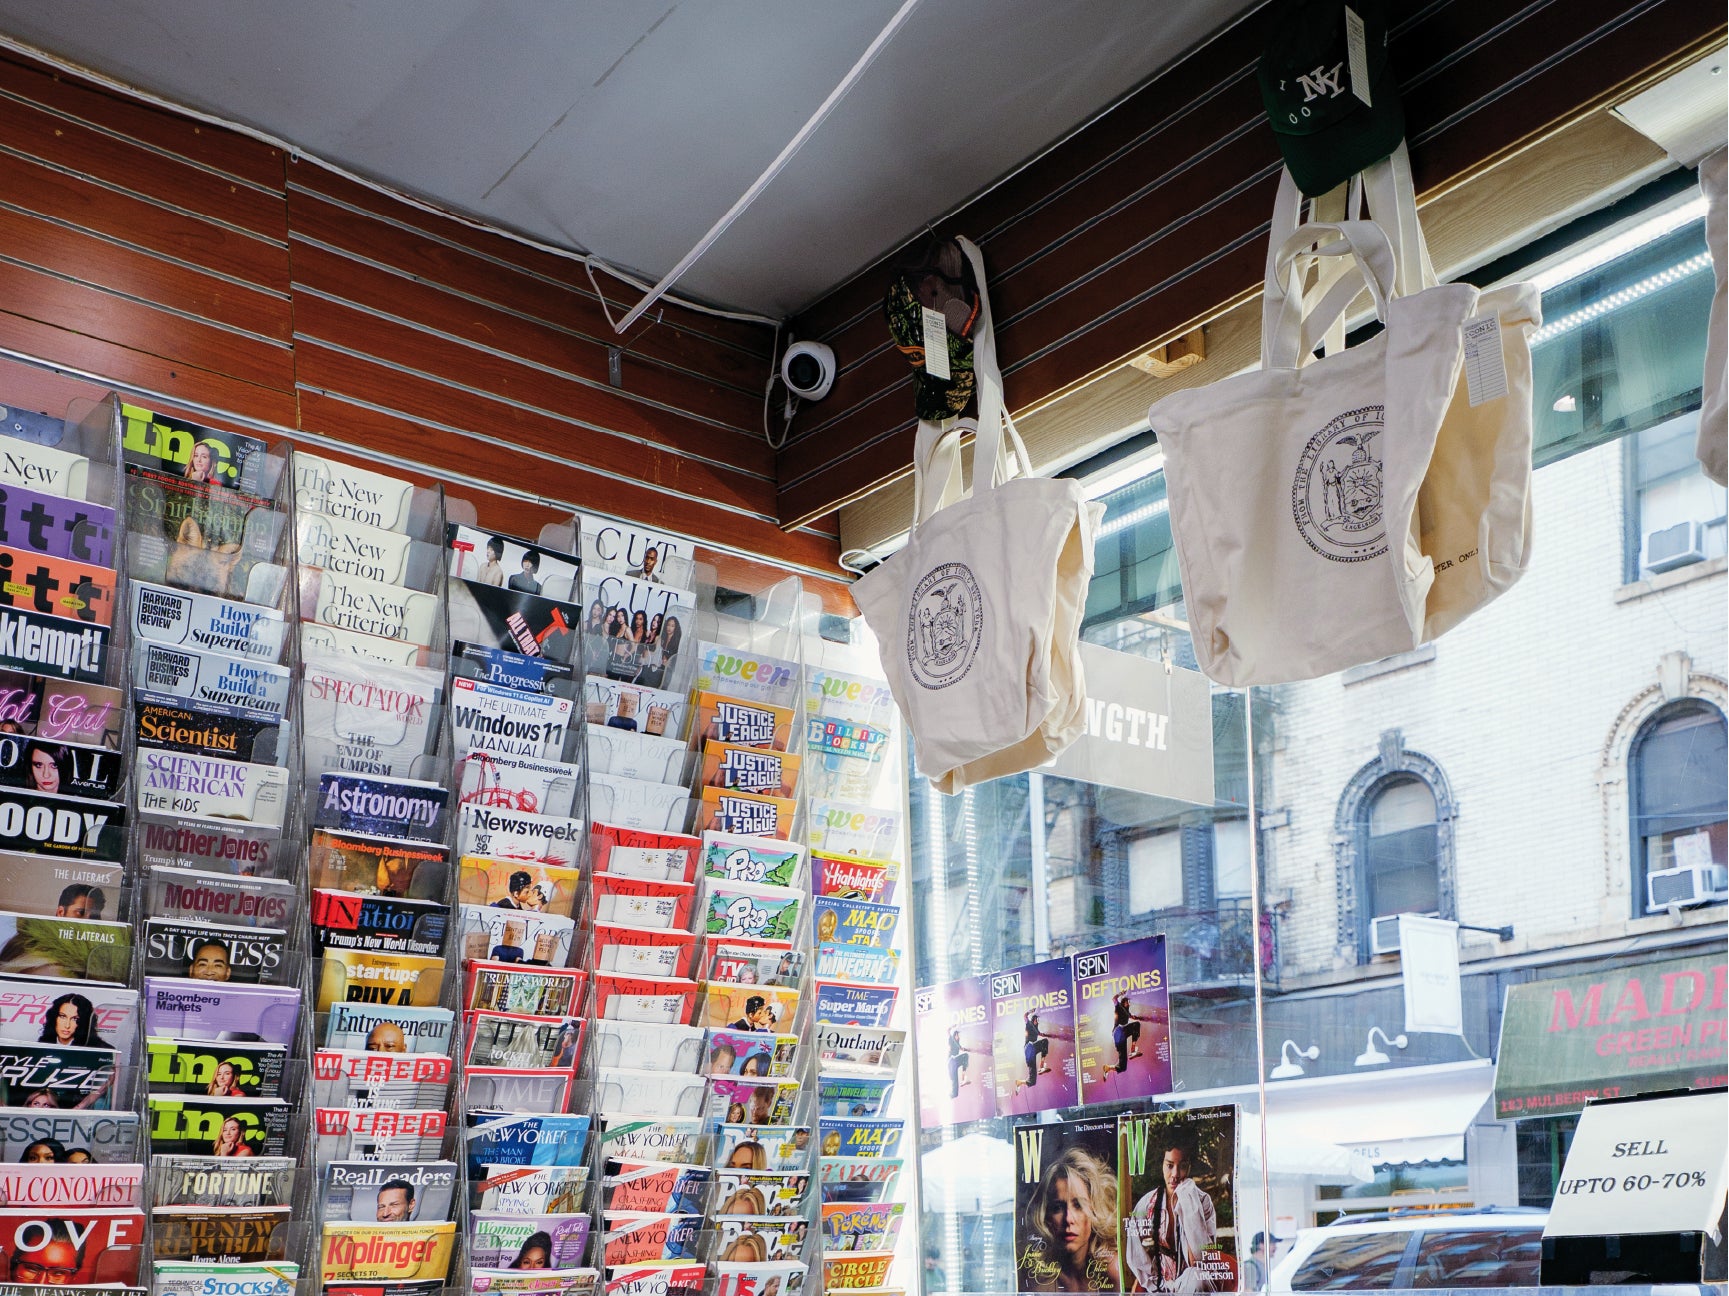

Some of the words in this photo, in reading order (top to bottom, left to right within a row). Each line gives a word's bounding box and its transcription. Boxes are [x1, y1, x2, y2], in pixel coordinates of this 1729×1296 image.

[1296, 61, 1345, 102] NY
[1354, 413, 1369, 422] OF
[121, 403, 237, 478] Inc.
[1307, 420, 1346, 463] LIBRARY
[1299, 468, 1308, 489] THE
[1298, 499, 1310, 526] FROM
[596, 526, 677, 574] CUT
[141, 603, 182, 621] BUSINESS
[142, 592, 183, 610] HARVARD
[328, 585, 364, 609] The
[367, 594, 410, 620] New
[140, 614, 171, 629] REVIEW
[323, 605, 408, 640] Criterion
[190, 628, 273, 657] Superteam
[150, 651, 190, 667] HARVARD
[702, 650, 792, 687] tween
[310, 675, 425, 718] SPECTATOR
[479, 697, 500, 709] THE
[500, 700, 547, 720] ULTIMATE
[712, 702, 775, 726] JUSTICE
[140, 715, 237, 750] Scientist
[719, 723, 773, 740] LEAGUE
[337, 745, 363, 759] END
[365, 749, 384, 761] OF
[472, 752, 518, 769] Bloomberg
[518, 761, 573, 777] Businessweek
[147, 753, 248, 782] SCIENTIFIC
[71, 779, 106, 789] Avenue
[145, 772, 246, 798] AMERICAN
[142, 792, 166, 810] THE
[171, 797, 200, 813] KIDS
[323, 781, 441, 828] Astronomy
[472, 809, 578, 843] Newsweek
[824, 865, 885, 890] Highlights
[164, 883, 235, 915] Mother
[236, 893, 287, 919] Jones
[58, 928, 74, 940] THE
[76, 930, 115, 944] LATERALS
[329, 933, 363, 946] Trump's
[363, 935, 384, 950] New
[384, 939, 406, 951] World
[407, 940, 439, 954] Disorder
[346, 963, 420, 983] startups
[818, 955, 895, 980] MINECRAFT
[1079, 955, 1108, 978] SPIN
[482, 973, 529, 986] TRUMP'S
[530, 976, 570, 989] WORLD
[993, 975, 1020, 996] SPIN
[1081, 969, 1162, 1001] DEFTONES
[155, 1000, 202, 1013] Markets
[156, 990, 221, 1006] Bloomberg
[846, 990, 870, 1000] TIME
[996, 990, 1068, 1017] DEFTONES
[818, 1000, 853, 1013] Super
[855, 1003, 889, 1015] Mario
[827, 1031, 900, 1051] Outlander
[1595, 1023, 1692, 1057] GREEN
[365, 1075, 385, 1087] ICE
[319, 1112, 444, 1136] WIRED
[1019, 1129, 1043, 1184] W
[1126, 1119, 1150, 1176] W
[1612, 1139, 1668, 1158] SELL
[182, 1172, 273, 1196] FORTUNE
[331, 1167, 451, 1188] RealLeaders
[1559, 1177, 1616, 1195] UPTO
[1623, 1171, 1706, 1191] 60-70%
[477, 1222, 536, 1237] Woman's
[1123, 1217, 1152, 1229] Teyana
[326, 1235, 437, 1269] Kiplinger
[1201, 1250, 1221, 1261] Paul
[831, 1260, 887, 1277] CIRCLE
[1194, 1260, 1230, 1271] Thomas
